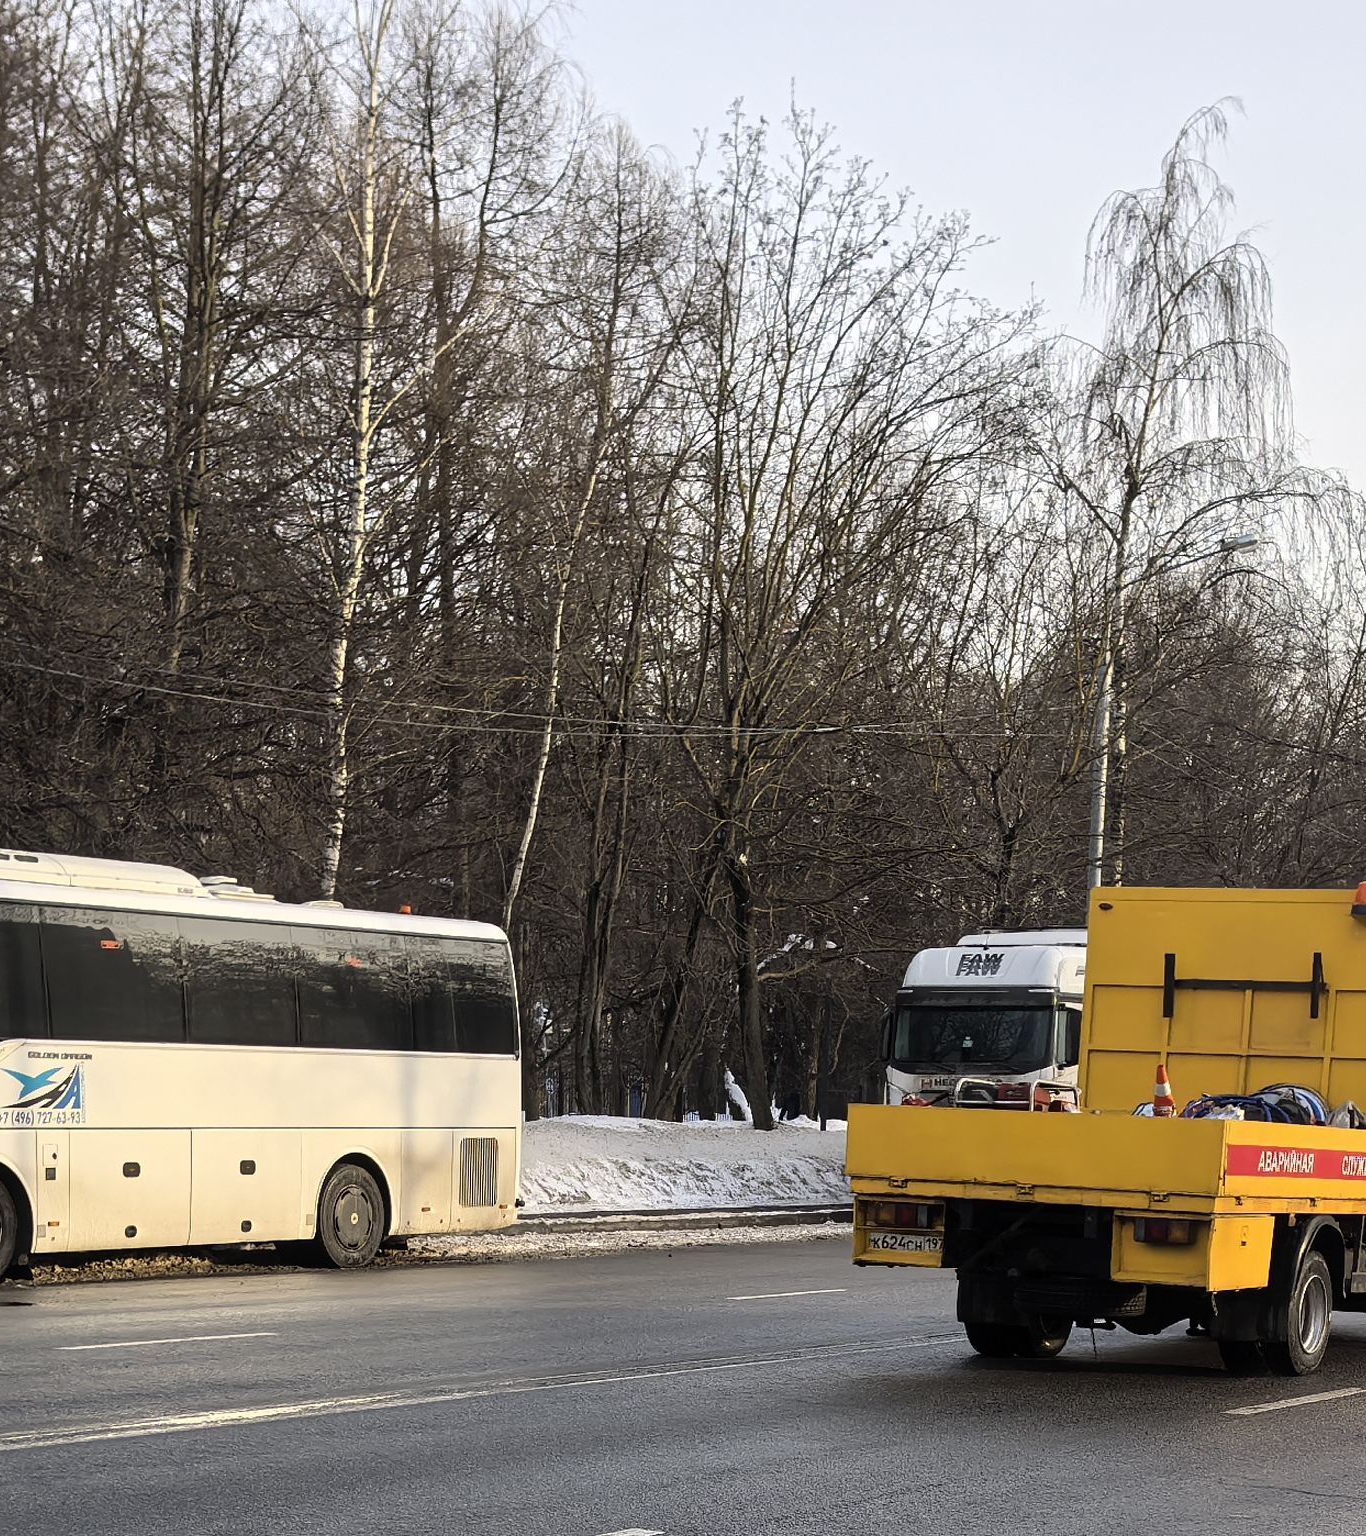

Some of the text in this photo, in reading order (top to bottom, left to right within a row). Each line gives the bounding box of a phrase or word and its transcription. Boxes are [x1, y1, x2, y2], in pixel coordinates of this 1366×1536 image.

[955, 953, 1005, 977] FAW
[11, 1110, 34, 1126] (496)
[1257, 1150, 1315, 1174] АВАРИЙНАЯ
